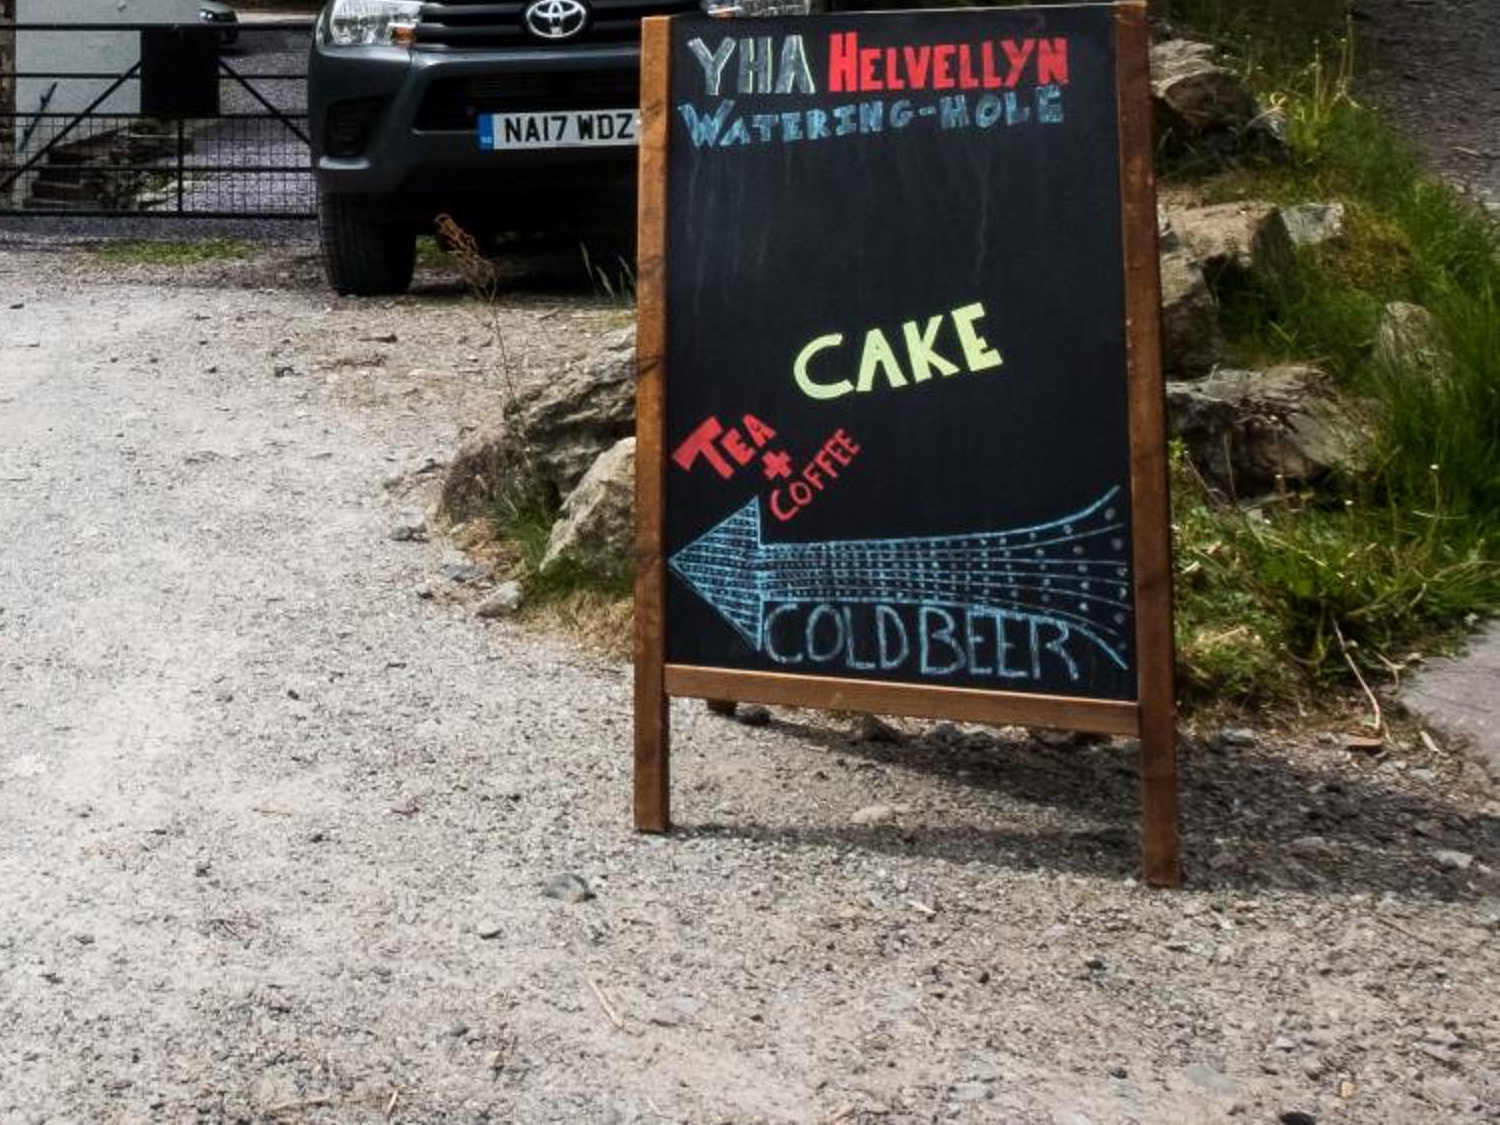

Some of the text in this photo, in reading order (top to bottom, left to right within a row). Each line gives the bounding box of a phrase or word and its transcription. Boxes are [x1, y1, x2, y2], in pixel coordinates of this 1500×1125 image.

[686, 31, 1071, 96] YHA HELVELLYN
[504, 115, 568, 143] NA17
[678, 84, 1065, 148] WATERING-HOLE
[793, 302, 1004, 401] CAKE
[672, 412, 776, 479] TEA
[768, 428, 862, 523] COFFEE
[763, 601, 1079, 681] COLD BEER
